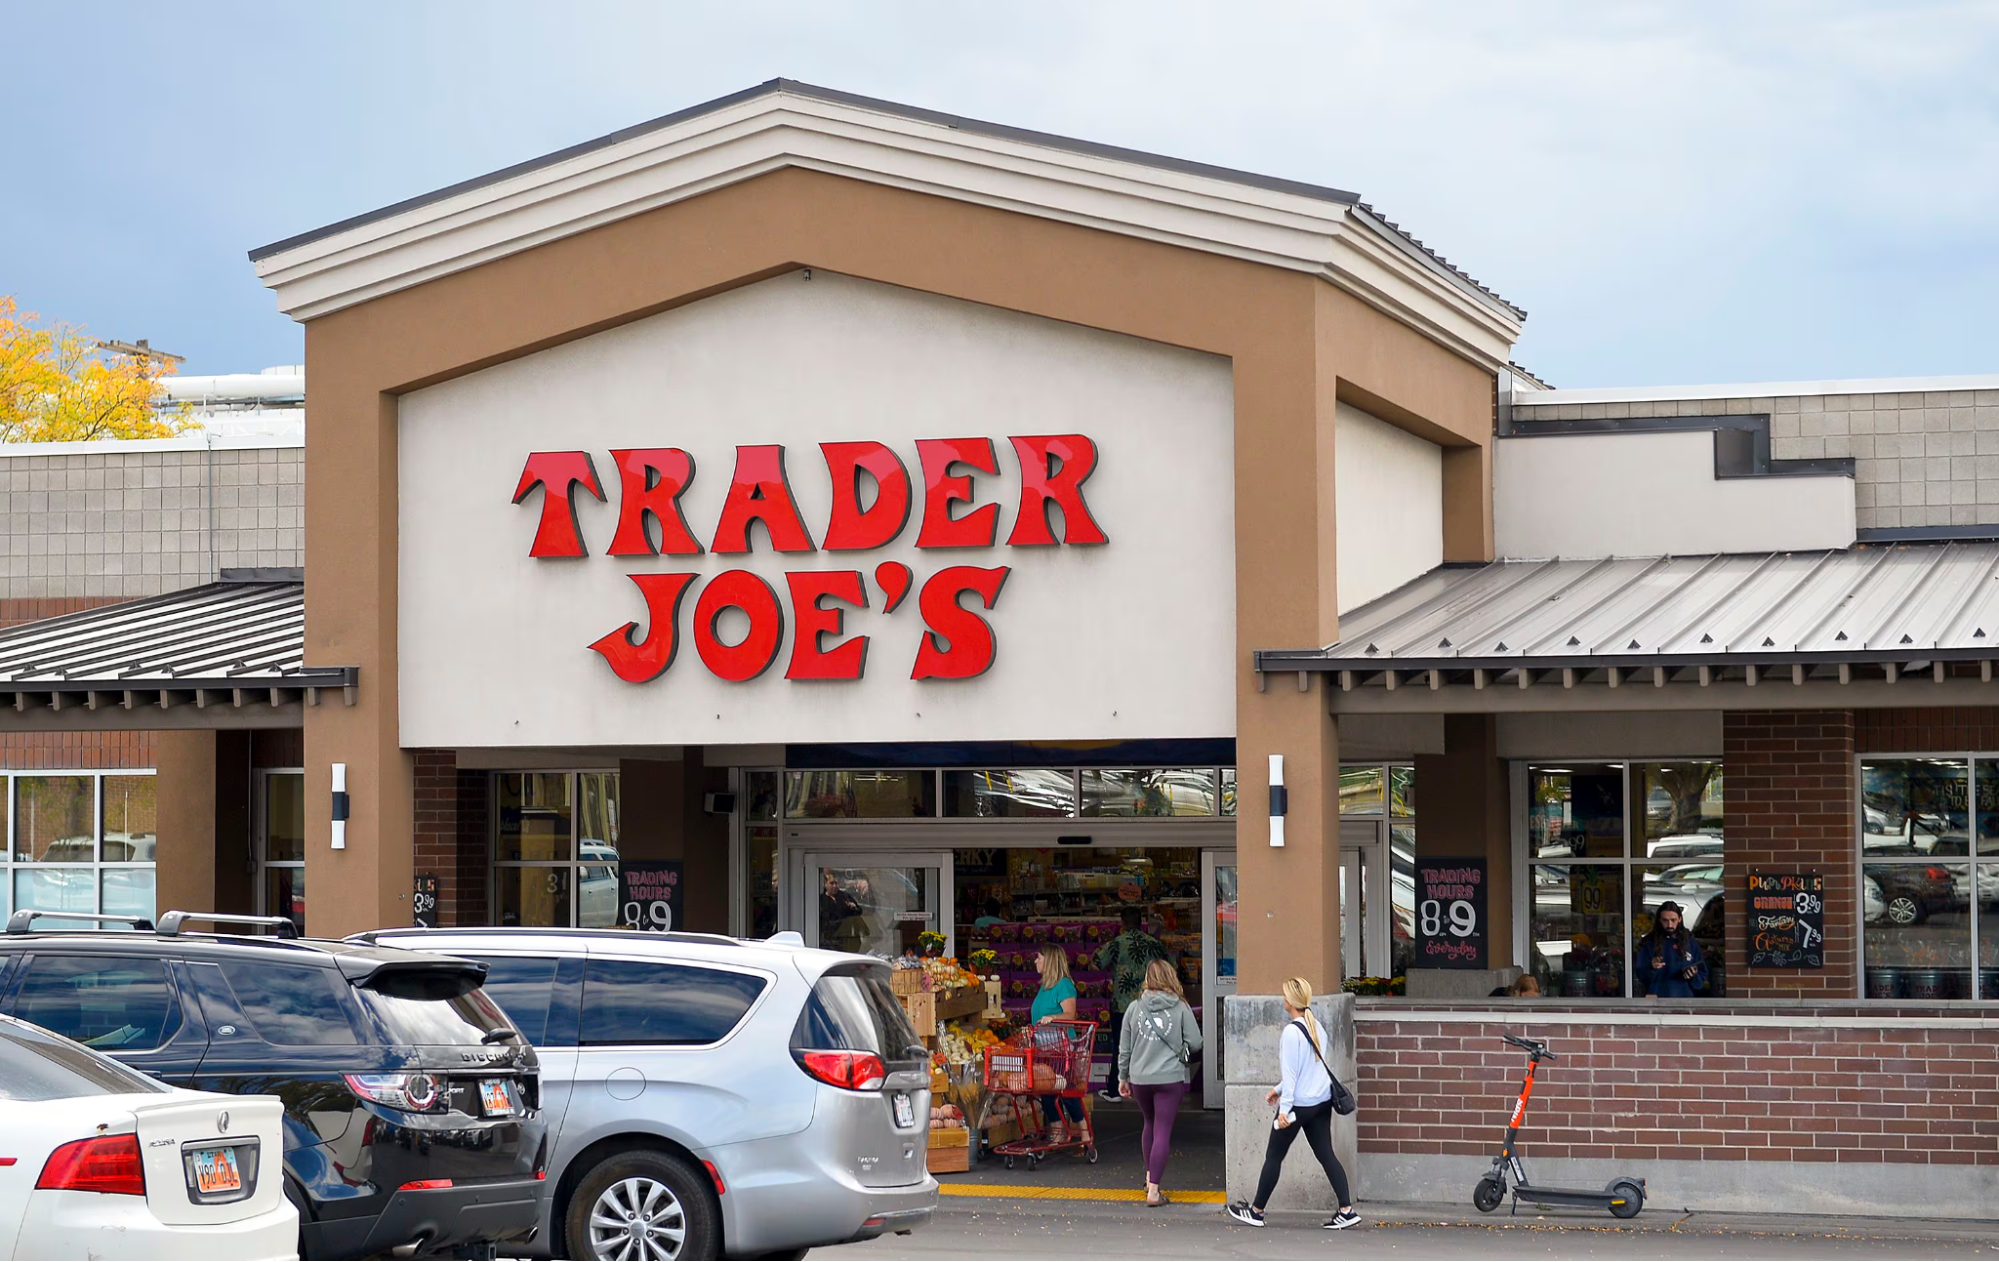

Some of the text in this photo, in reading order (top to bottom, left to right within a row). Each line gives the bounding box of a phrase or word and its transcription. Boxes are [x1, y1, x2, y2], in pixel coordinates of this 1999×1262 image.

[511, 433, 1110, 559] TRADER
[586, 560, 1012, 684] JOE'S
[624, 869, 678, 886] TRADING
[1420, 867, 1482, 885] TRADING
[629, 886, 672, 901] HOURS
[1426, 884, 1475, 900] HOURS
[649, 900, 672, 932] 9
[1420, 899, 1441, 937] 8
[1448, 899, 1477, 938] 9
